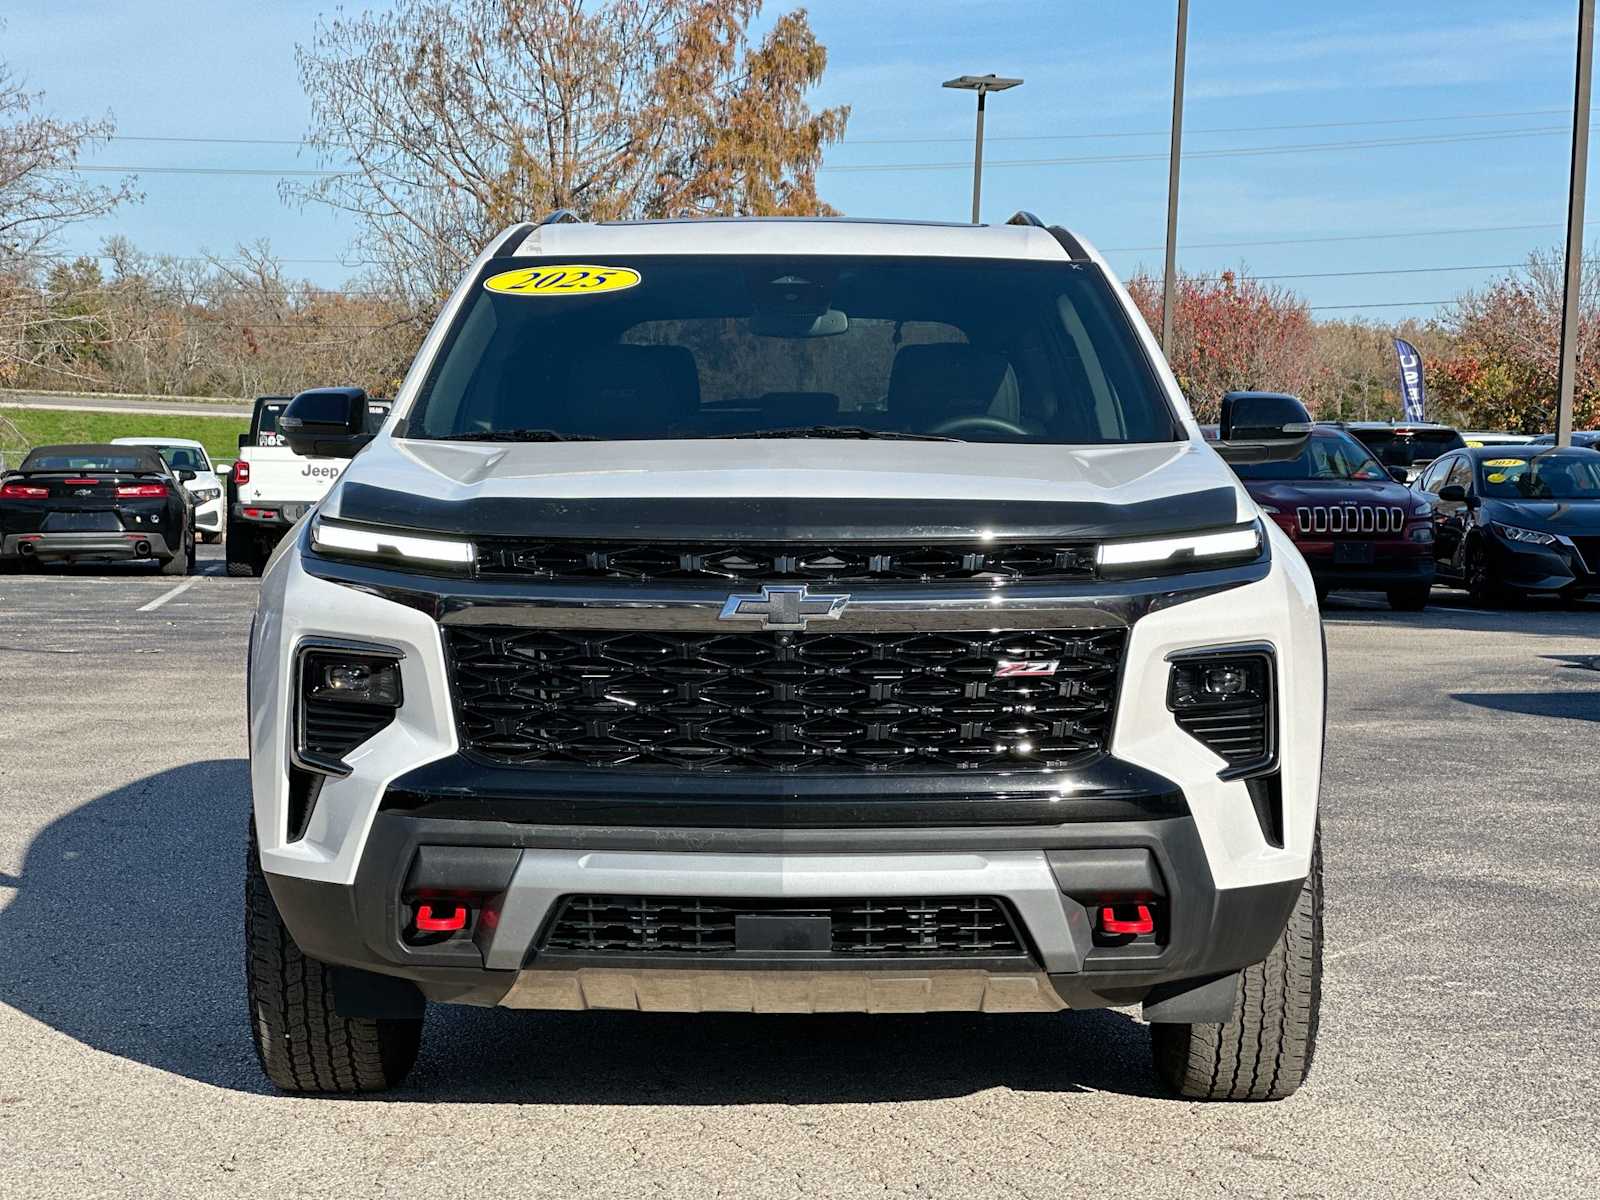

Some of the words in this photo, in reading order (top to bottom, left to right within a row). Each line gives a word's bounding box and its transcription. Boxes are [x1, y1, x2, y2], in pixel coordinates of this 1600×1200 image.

[506, 272, 617, 289] 2025
[301, 463, 339, 479] Jeep
[995, 660, 1061, 677] Z71
